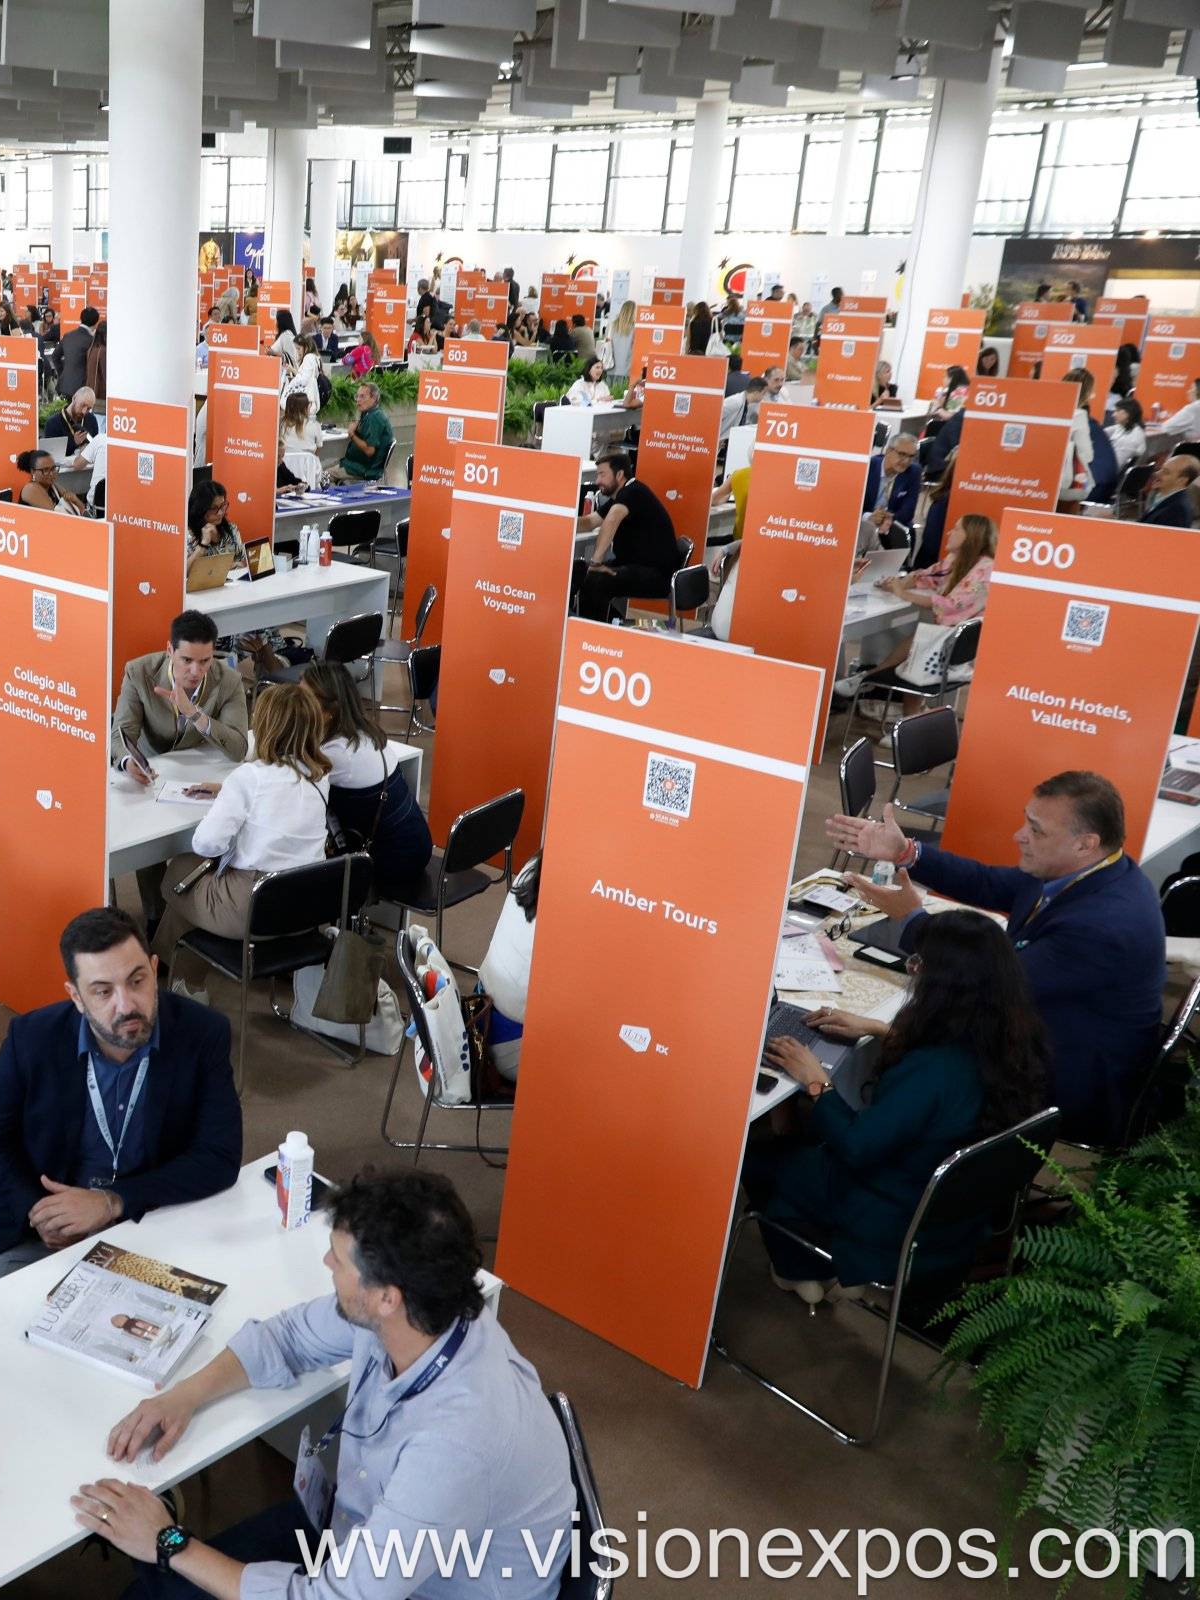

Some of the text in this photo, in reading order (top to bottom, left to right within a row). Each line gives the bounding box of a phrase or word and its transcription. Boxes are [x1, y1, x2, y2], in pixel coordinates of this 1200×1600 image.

[826, 322, 844, 333] 503
[212, 333, 228, 344] 604
[1052, 334, 1075, 344] 502
[448, 350, 468, 362] 603
[220, 366, 240, 380] 703
[652, 366, 677, 380] 602
[424, 385, 448, 400] 702
[974, 391, 1008, 408] 601
[112, 415, 137, 434] 802
[765, 420, 798, 440] 701
[242, 438, 258, 448] Miami
[646, 440, 670, 450] London
[678, 442, 690, 451] The
[653, 430, 704, 444] The Dorchester,
[224, 446, 264, 459] Coconut Grove
[666, 450, 686, 460] Dubai
[421, 464, 438, 474] AMV
[464, 462, 498, 487] 801
[419, 476, 440, 485] Alvear
[959, 481, 982, 492] Plaza
[1025, 488, 1048, 500] Paris
[118, 515, 127, 524] LA
[128, 516, 152, 529] CARTE
[152, 520, 180, 534] TRAVEL
[767, 514, 833, 533] Asia Exotica &
[1016, 524, 1053, 534] Boulevard
[759, 526, 838, 548] Capella Bangkok
[1011, 538, 1076, 569] 800
[475, 578, 536, 601] Atlas Ocean
[483, 596, 525, 615] Voyages
[582, 641, 624, 658] Boulevard
[14, 666, 77, 698] Collegio alla
[578, 661, 652, 708] 900
[4, 682, 88, 721] Querce, Auberge
[1006, 686, 1133, 724] Allelon Hotels,
[50, 716, 96, 743] Florence
[1031, 710, 1098, 735] Valletta
[590, 879, 718, 934] Amber Tours
